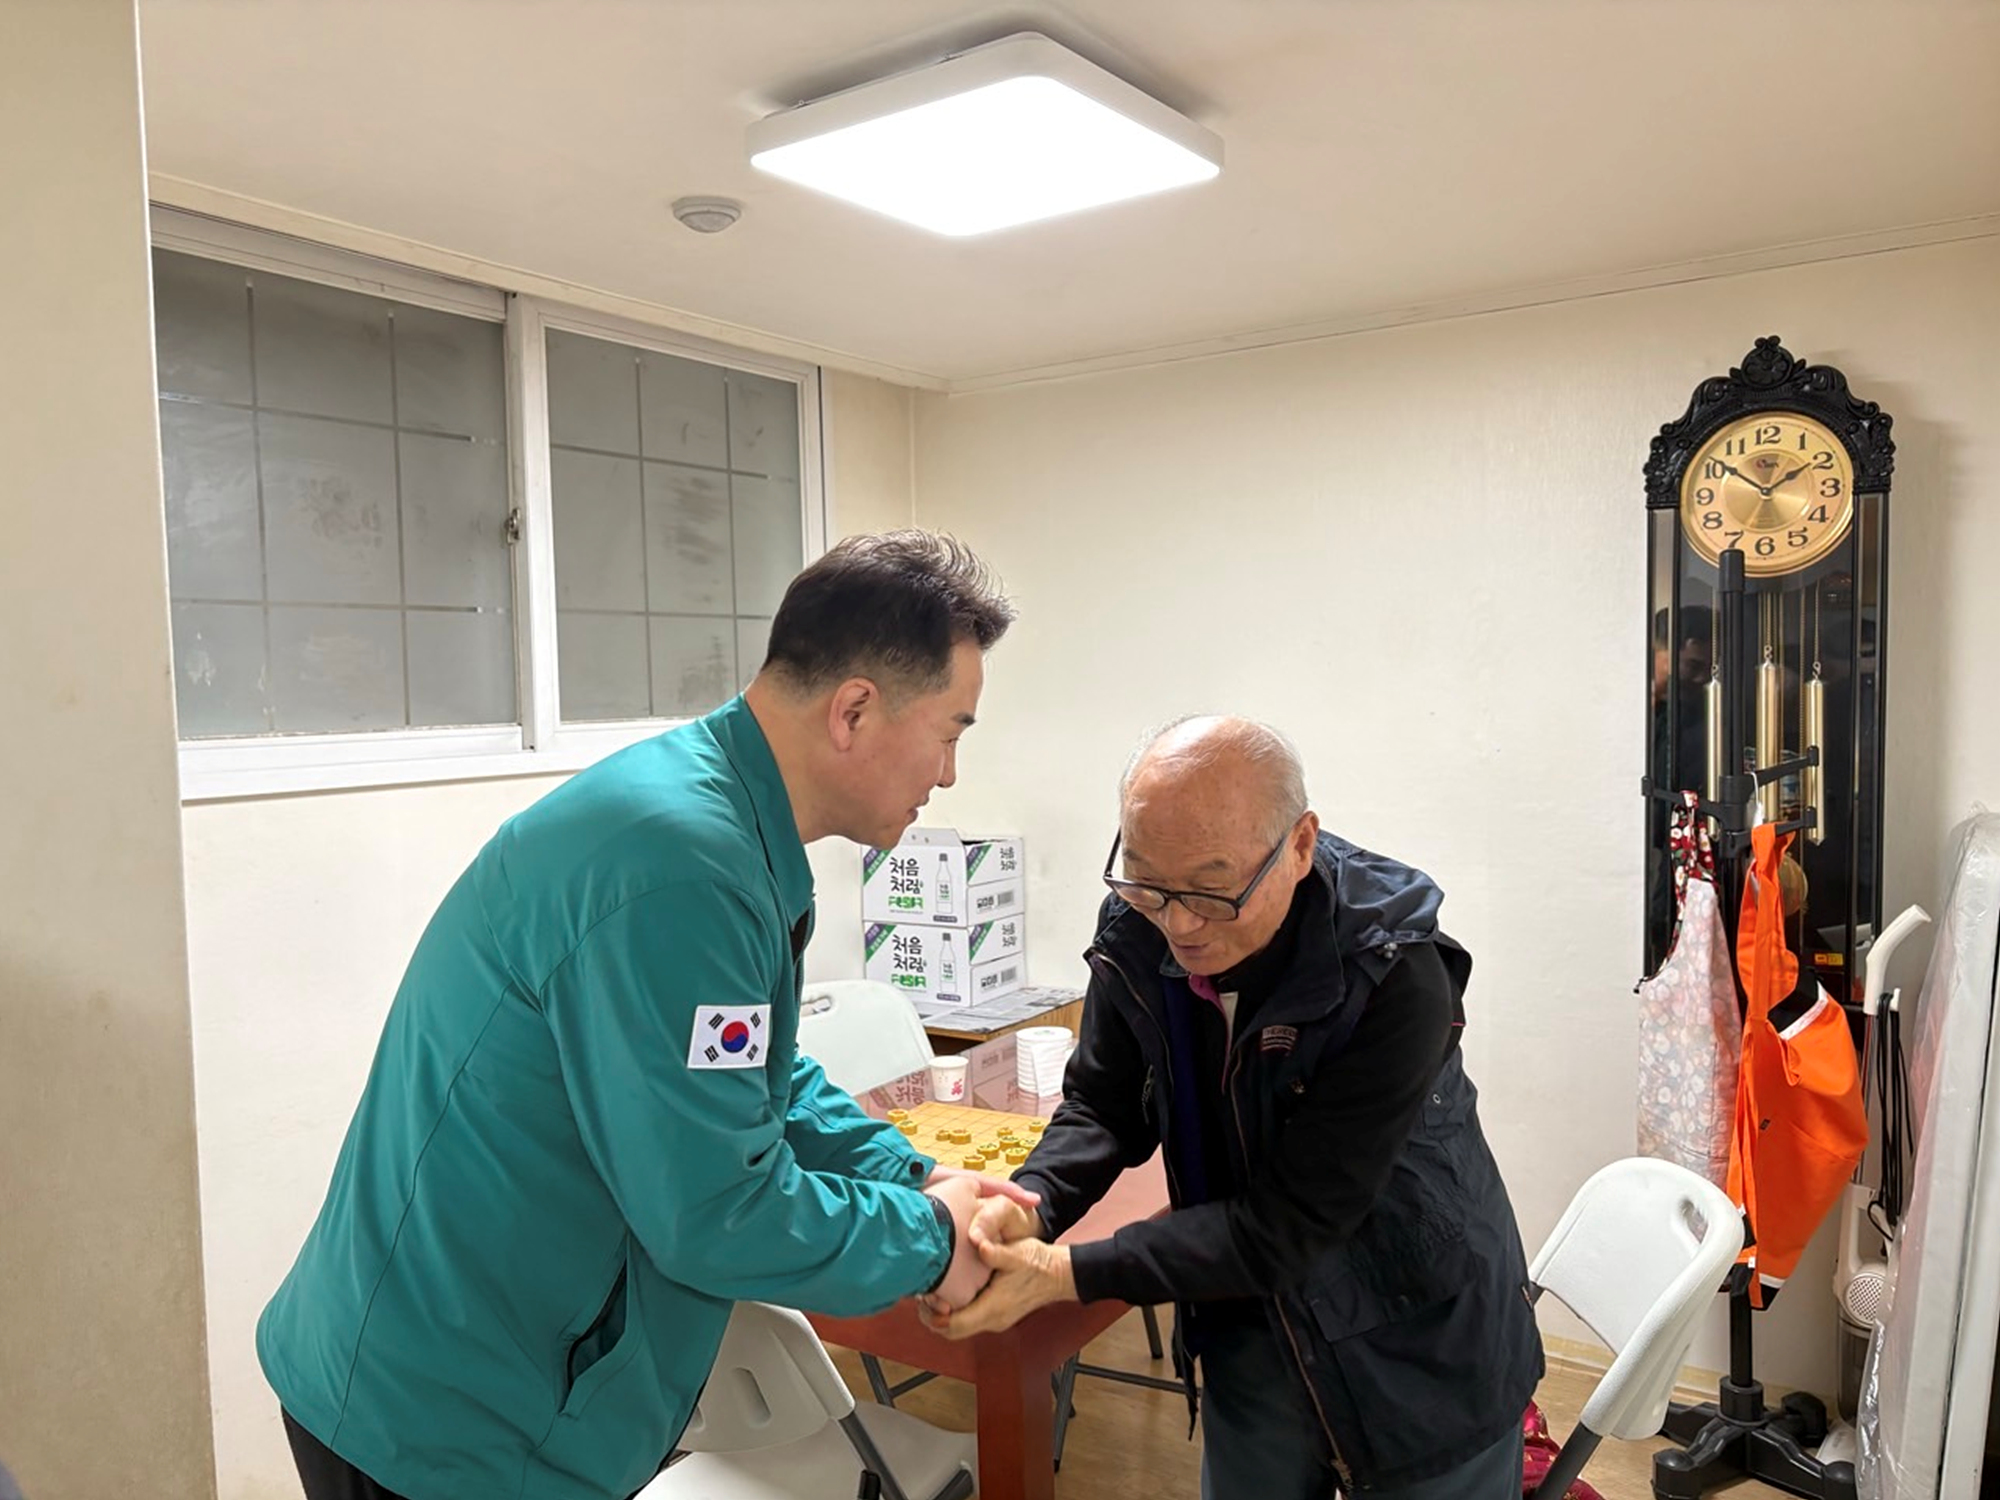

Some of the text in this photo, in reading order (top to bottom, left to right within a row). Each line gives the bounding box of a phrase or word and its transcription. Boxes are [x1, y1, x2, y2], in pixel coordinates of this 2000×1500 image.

[1755, 425, 1781, 446] 12
[1798, 431, 1807, 450] 1
[1725, 437, 1746, 456] 11
[1812, 451, 1834, 470] 2
[1704, 461, 1726, 480] 10
[1695, 487, 1714, 506] 9
[1820, 477, 1841, 498] 3
[1702, 511, 1723, 530] 8
[1808, 504, 1829, 523] 4
[1724, 530, 1744, 549] 7
[1754, 536, 1776, 556] 6
[1787, 526, 1809, 547] 5
[889, 857, 920, 877] 처음
[890, 876, 921, 895] 처럼
[891, 934, 923, 955] 처음
[892, 953, 925, 973] 처럼
